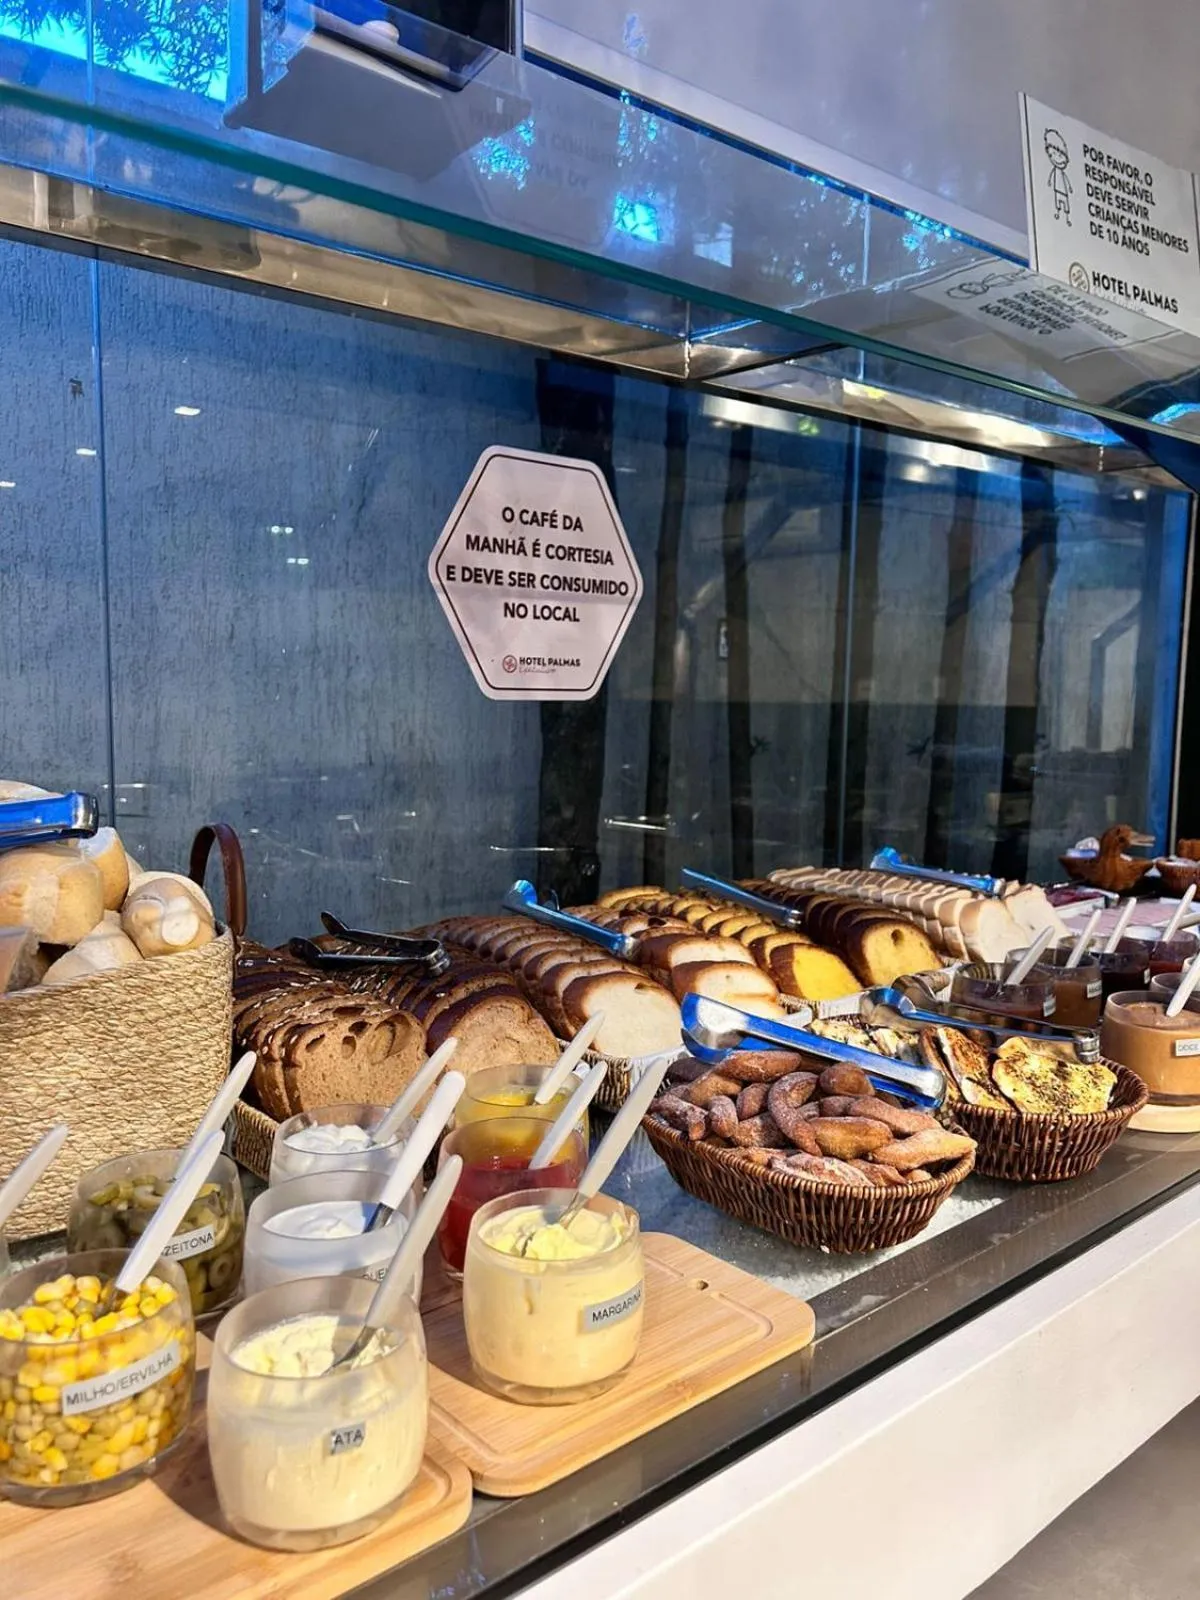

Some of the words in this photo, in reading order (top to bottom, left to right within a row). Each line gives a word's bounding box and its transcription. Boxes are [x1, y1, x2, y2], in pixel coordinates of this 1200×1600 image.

[1083, 144, 1105, 166] POR
[1144, 173, 1153, 187] O
[1085, 163, 1156, 206] RESPONSÁVEL
[1086, 182, 1113, 206] DEVE
[1115, 195, 1149, 220] SERVIR
[1088, 202, 1139, 235] CRIANÇAS
[1141, 223, 1189, 253] MENORES
[1090, 221, 1105, 239] DE
[1107, 228, 1119, 245] 10
[1121, 235, 1150, 256] ANOS
[1092, 271, 1131, 298] HOTEL
[1132, 285, 1179, 314] PALMAS
[502, 506, 515, 522] O
[519, 509, 558, 529] CAFÉ
[562, 515, 584, 532] DA
[465, 534, 528, 557] MANHÃ
[532, 539, 541, 558] É
[545, 544, 614, 566] CORTESIA
[446, 565, 456, 581] E
[461, 566, 504, 586] DEVE
[508, 571, 536, 588] SER
[540, 574, 629, 596] CONSUMIDO
[503, 602, 528, 619] NO
[532, 604, 580, 623] LOCAL
[519, 657, 546, 667] HOTEL
[548, 657, 581, 667] PALMAS
[161, 1232, 213, 1256] ZEITONA
[66, 1352, 174, 1407] MILHO/ERVILHA
[333, 1429, 365, 1446] ATA
